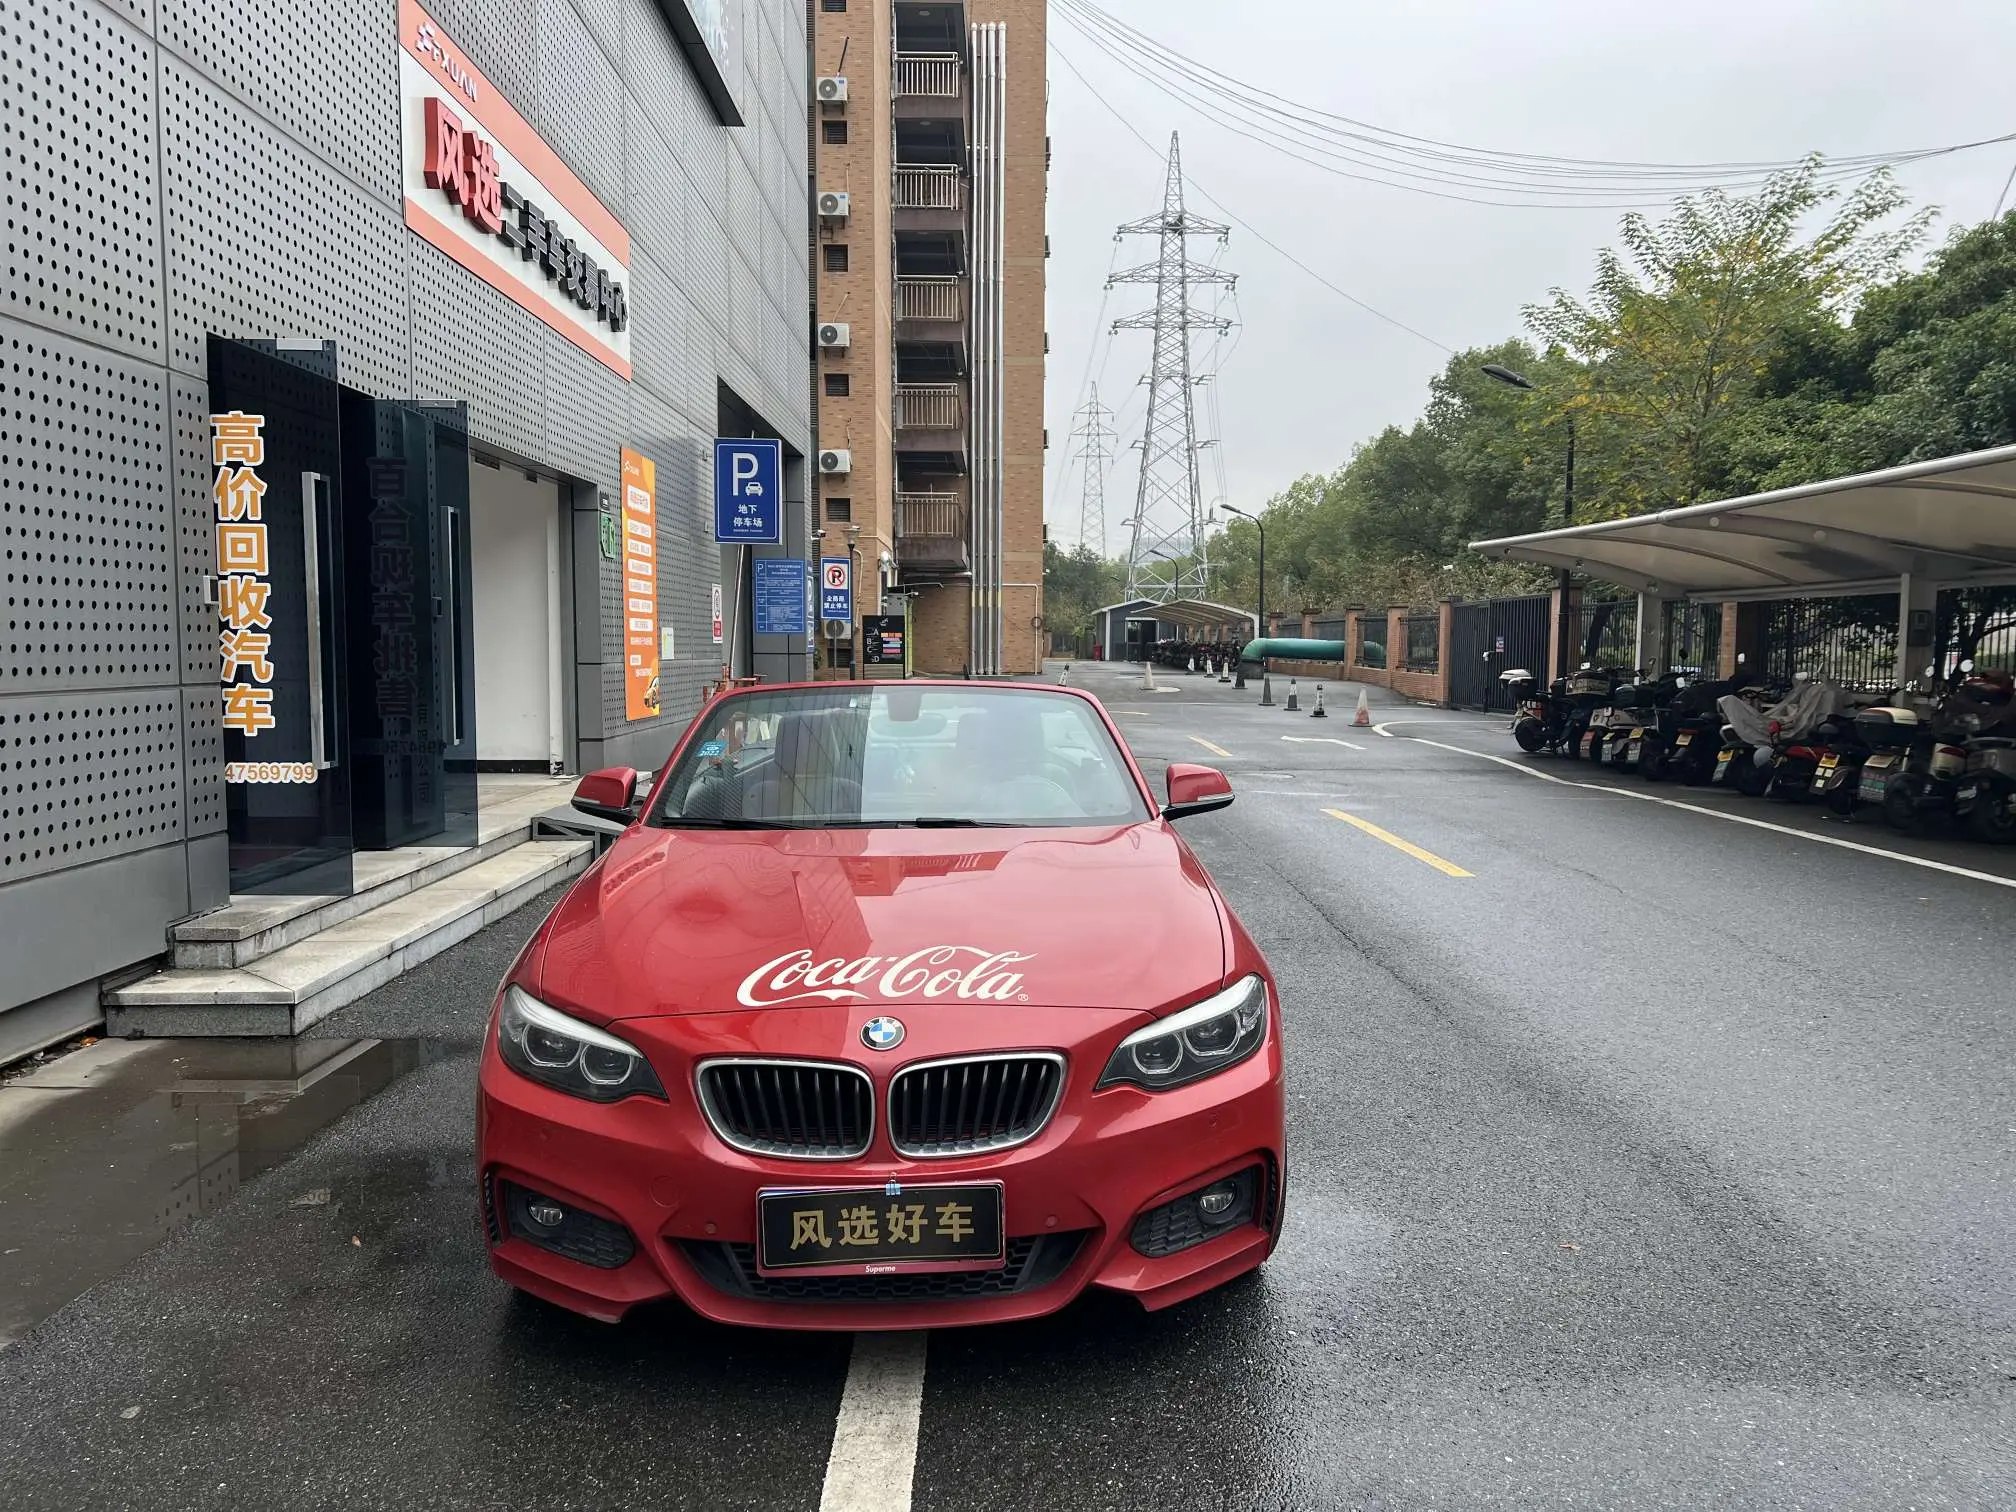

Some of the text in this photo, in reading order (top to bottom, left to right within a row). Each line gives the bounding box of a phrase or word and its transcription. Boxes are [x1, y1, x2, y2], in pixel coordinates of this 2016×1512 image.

[732, 452, 758, 496] P
[733, 517, 763, 528] 停车场
[738, 504, 757, 514] 地下
[210, 411, 275, 736] 高价回收汽车
[737, 945, 1038, 1007] Coca-Cola
[790, 1202, 974, 1250] 风选好车
